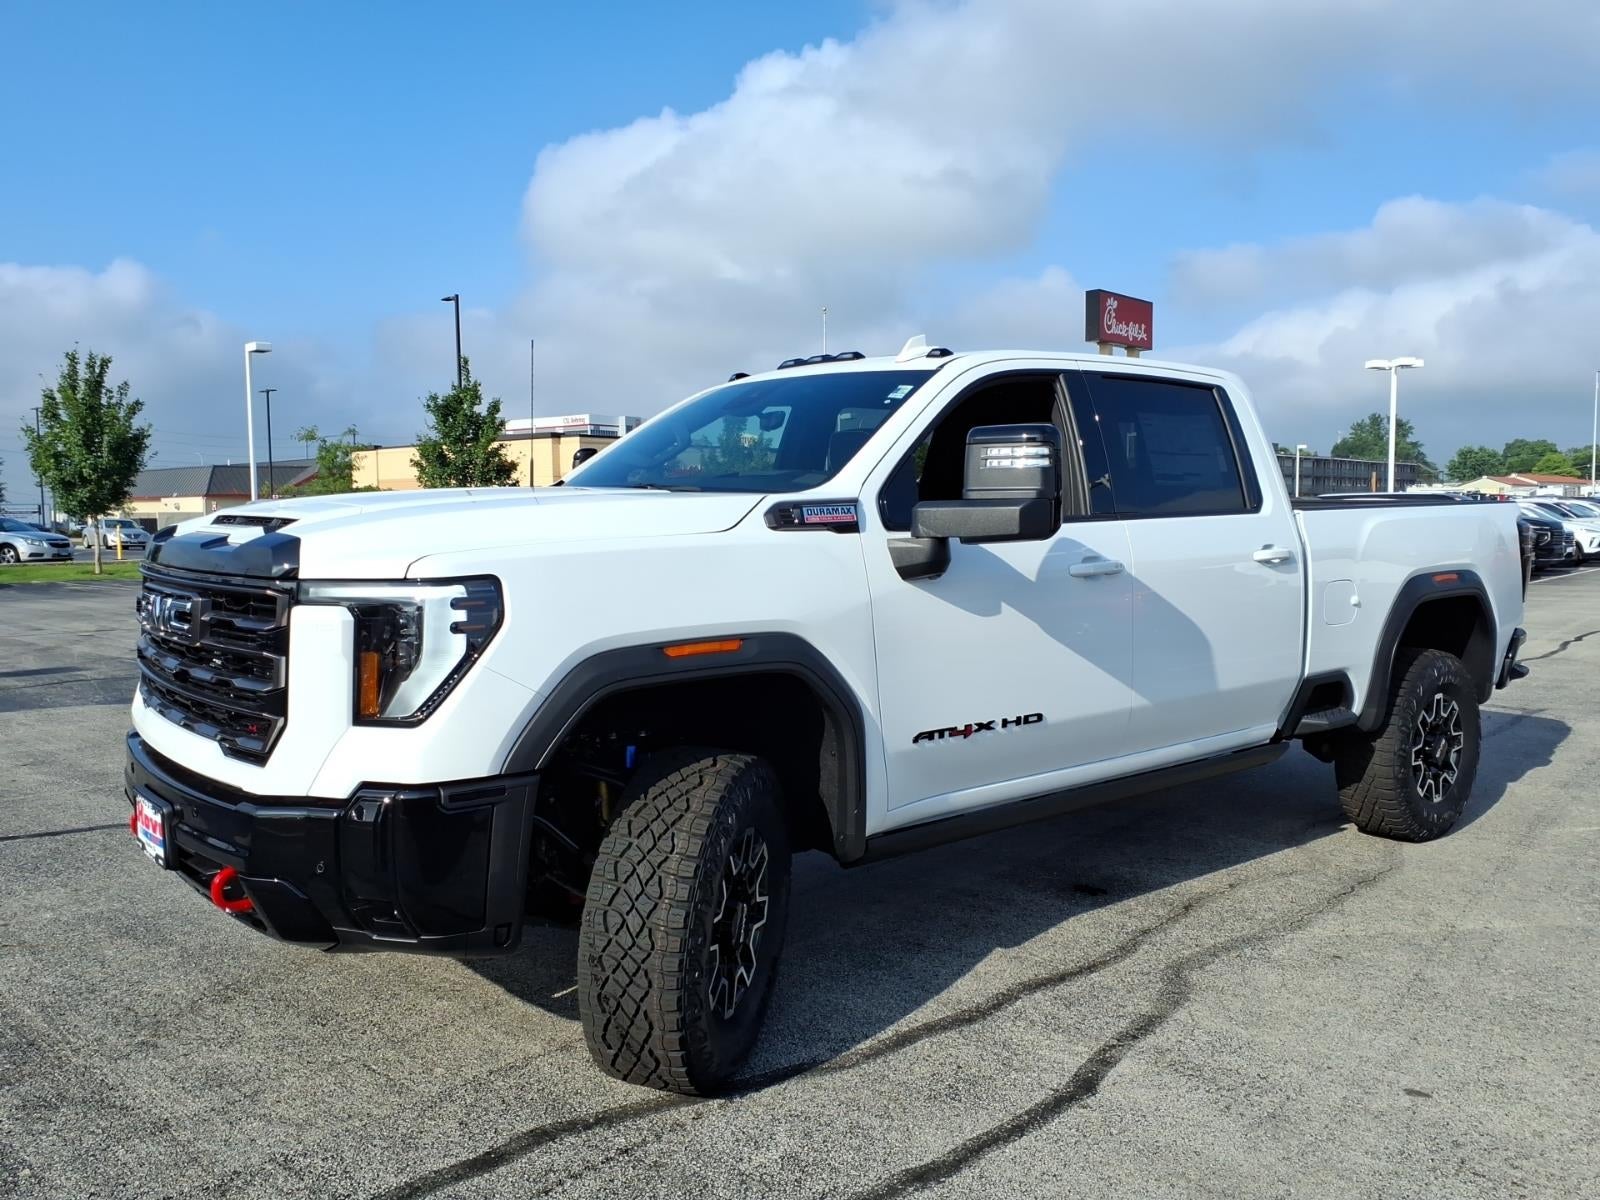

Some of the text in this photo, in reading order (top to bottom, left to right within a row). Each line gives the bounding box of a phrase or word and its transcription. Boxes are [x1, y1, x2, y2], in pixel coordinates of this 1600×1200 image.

[1104, 306, 1147, 341] Chick-fil-A
[806, 506, 852, 516] DURAMAX
[912, 712, 1044, 744] AT4X HD
